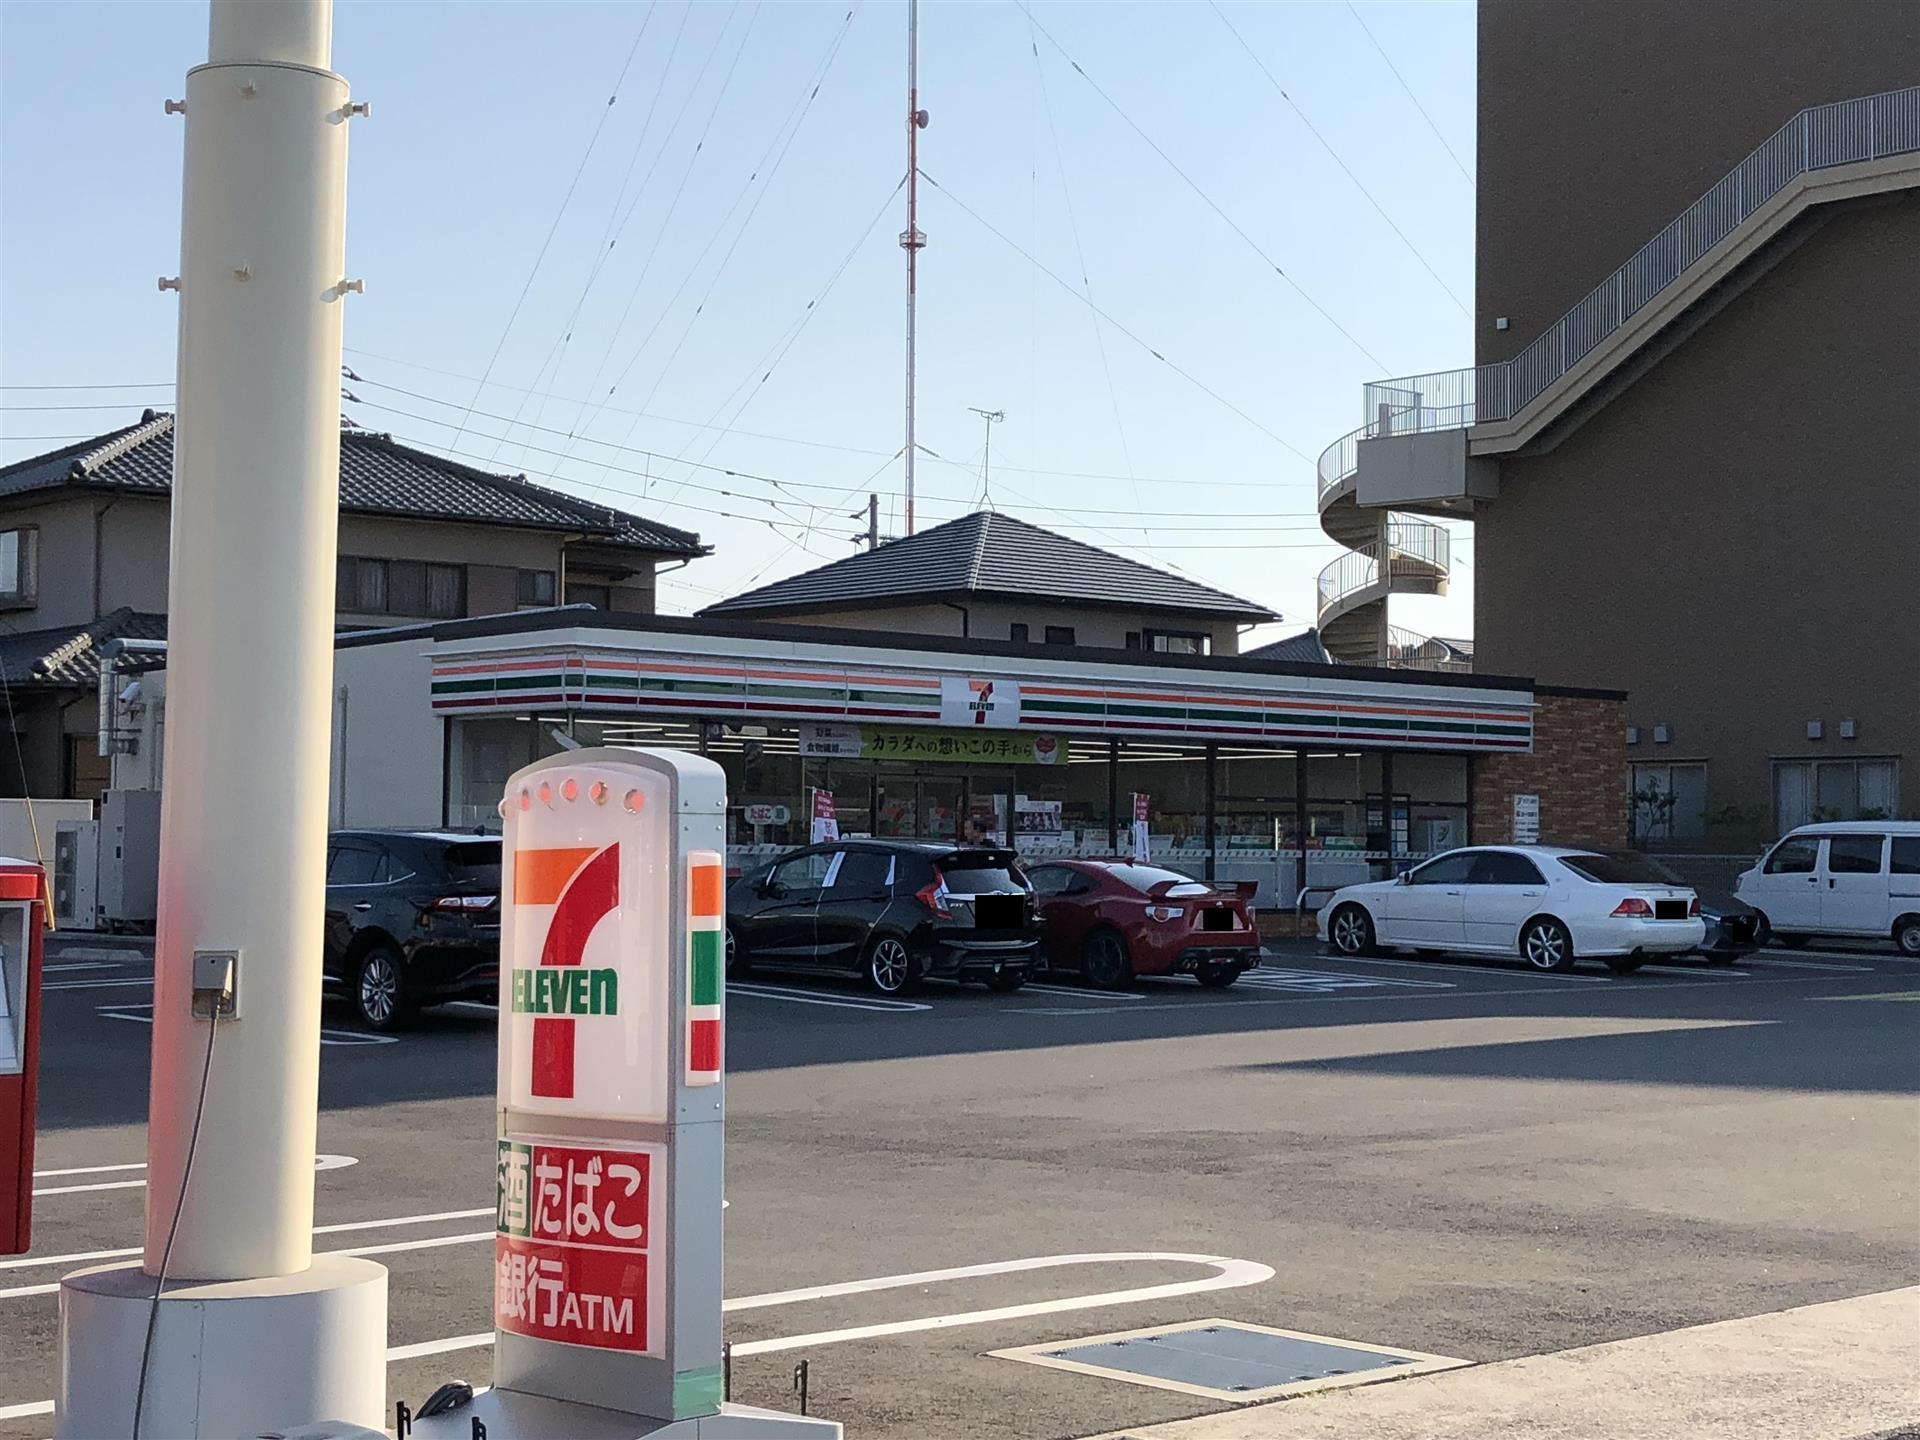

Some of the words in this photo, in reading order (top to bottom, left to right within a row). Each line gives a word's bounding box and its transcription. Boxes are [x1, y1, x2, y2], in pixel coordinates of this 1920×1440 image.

[513, 841, 620, 1098] 7
[534, 1154, 643, 1240] たばこ
